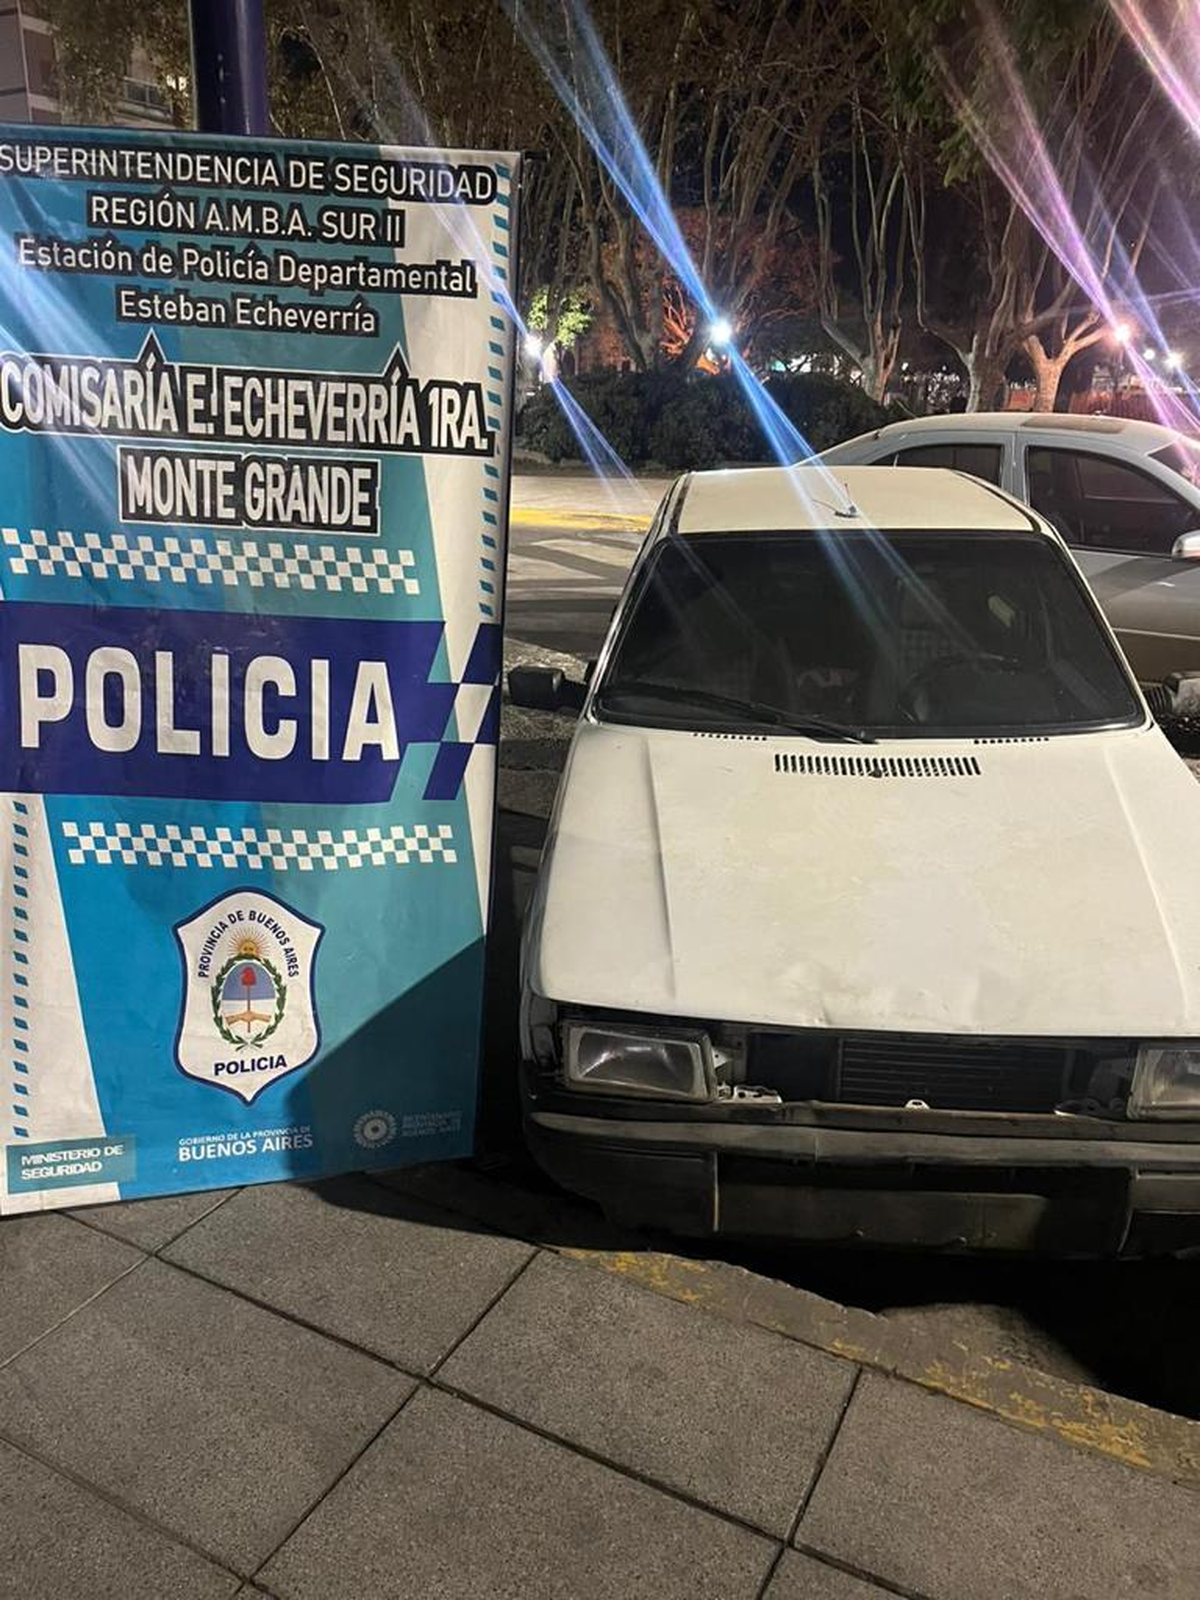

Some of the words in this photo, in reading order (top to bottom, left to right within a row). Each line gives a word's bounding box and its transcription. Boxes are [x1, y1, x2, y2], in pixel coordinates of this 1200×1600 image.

[0, 143, 279, 187] SUPERINTENDENCIA
[289, 160, 325, 190] DE
[334, 162, 494, 201] SEGURIDAD
[91, 188, 195, 230] REGIÓN
[205, 201, 312, 237] A.M.B.A.
[322, 210, 380, 241] SUR
[386, 215, 401, 242] II
[19, 238, 133, 273] Estación
[143, 245, 173, 274] de
[183, 246, 270, 281] Policía
[278, 254, 474, 293] Departamental
[121, 290, 226, 323] Esteban
[236, 295, 376, 333] Echeverría
[1, 356, 179, 432] COMISARÍA
[225, 369, 420, 446] ECHEVERRÍA
[428, 385, 489, 450] 1RA.
[126, 456, 237, 519] MONTE
[244, 461, 372, 526] GRANDE
[18, 643, 400, 761] POLICIA
[198, 921, 229, 978] PROVINCIA
[228, 910, 245, 925] DE
[249, 910, 290, 946] BUENOS
[284, 947, 300, 977] AIRES
[214, 1054, 287, 1076] POLICIA
[22, 1147, 101, 1166] MINISTERIO
[104, 1144, 124, 1156] DE
[179, 1134, 225, 1147] GOBIERNO
[227, 1132, 238, 1141] DE
[240, 1130, 251, 1140] LA
[179, 1139, 257, 1162] BUENOS
[262, 1134, 313, 1153] AIRES
[22, 1161, 102, 1180] SEGURIDAD
